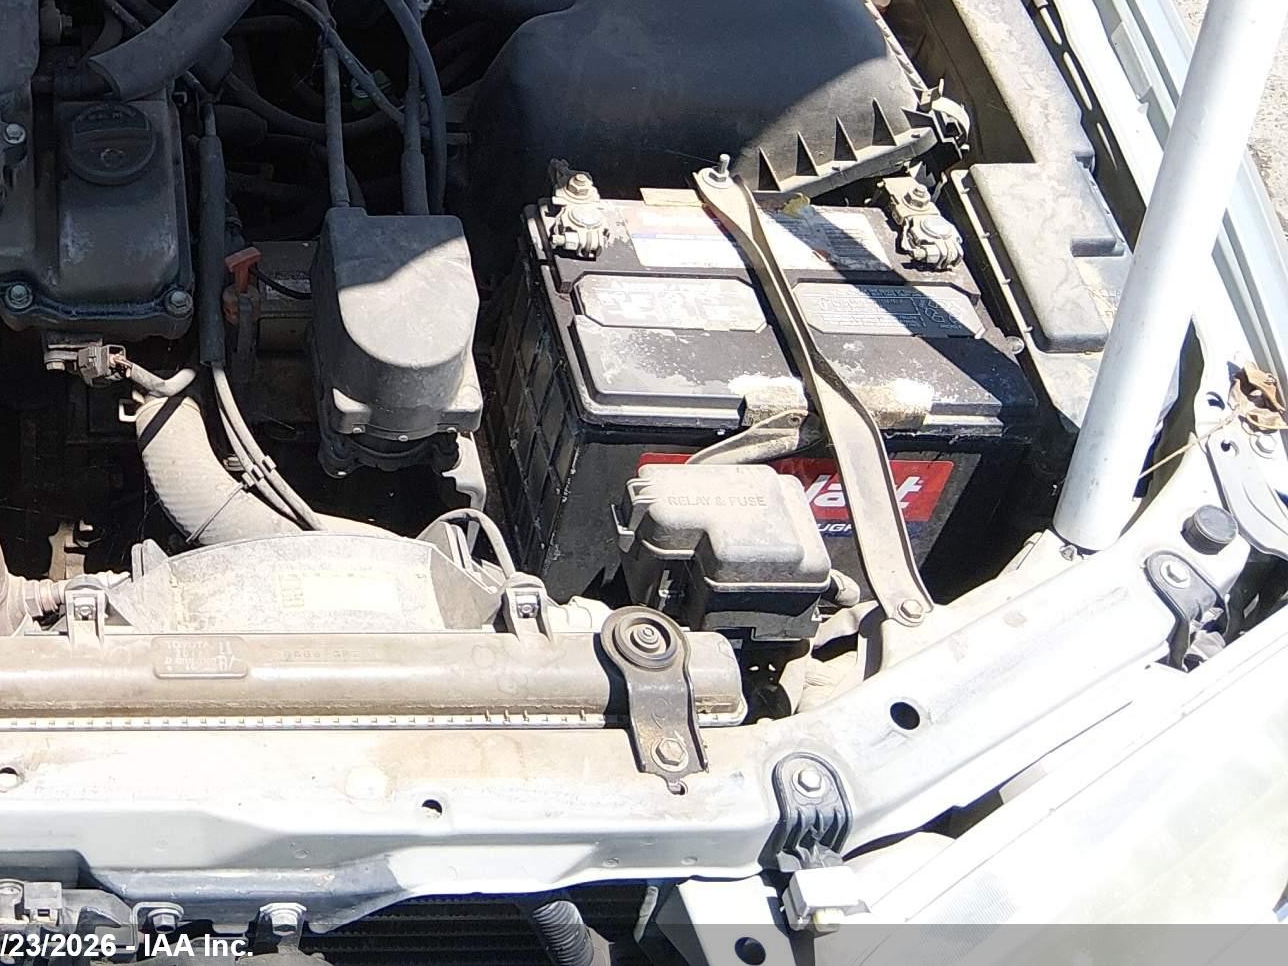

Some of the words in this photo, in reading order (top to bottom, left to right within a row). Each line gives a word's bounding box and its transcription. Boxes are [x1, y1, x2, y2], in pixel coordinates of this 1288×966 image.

[667, 496, 711, 506] RELAY
[715, 496, 727, 506] &
[729, 496, 768, 506] FUSE
